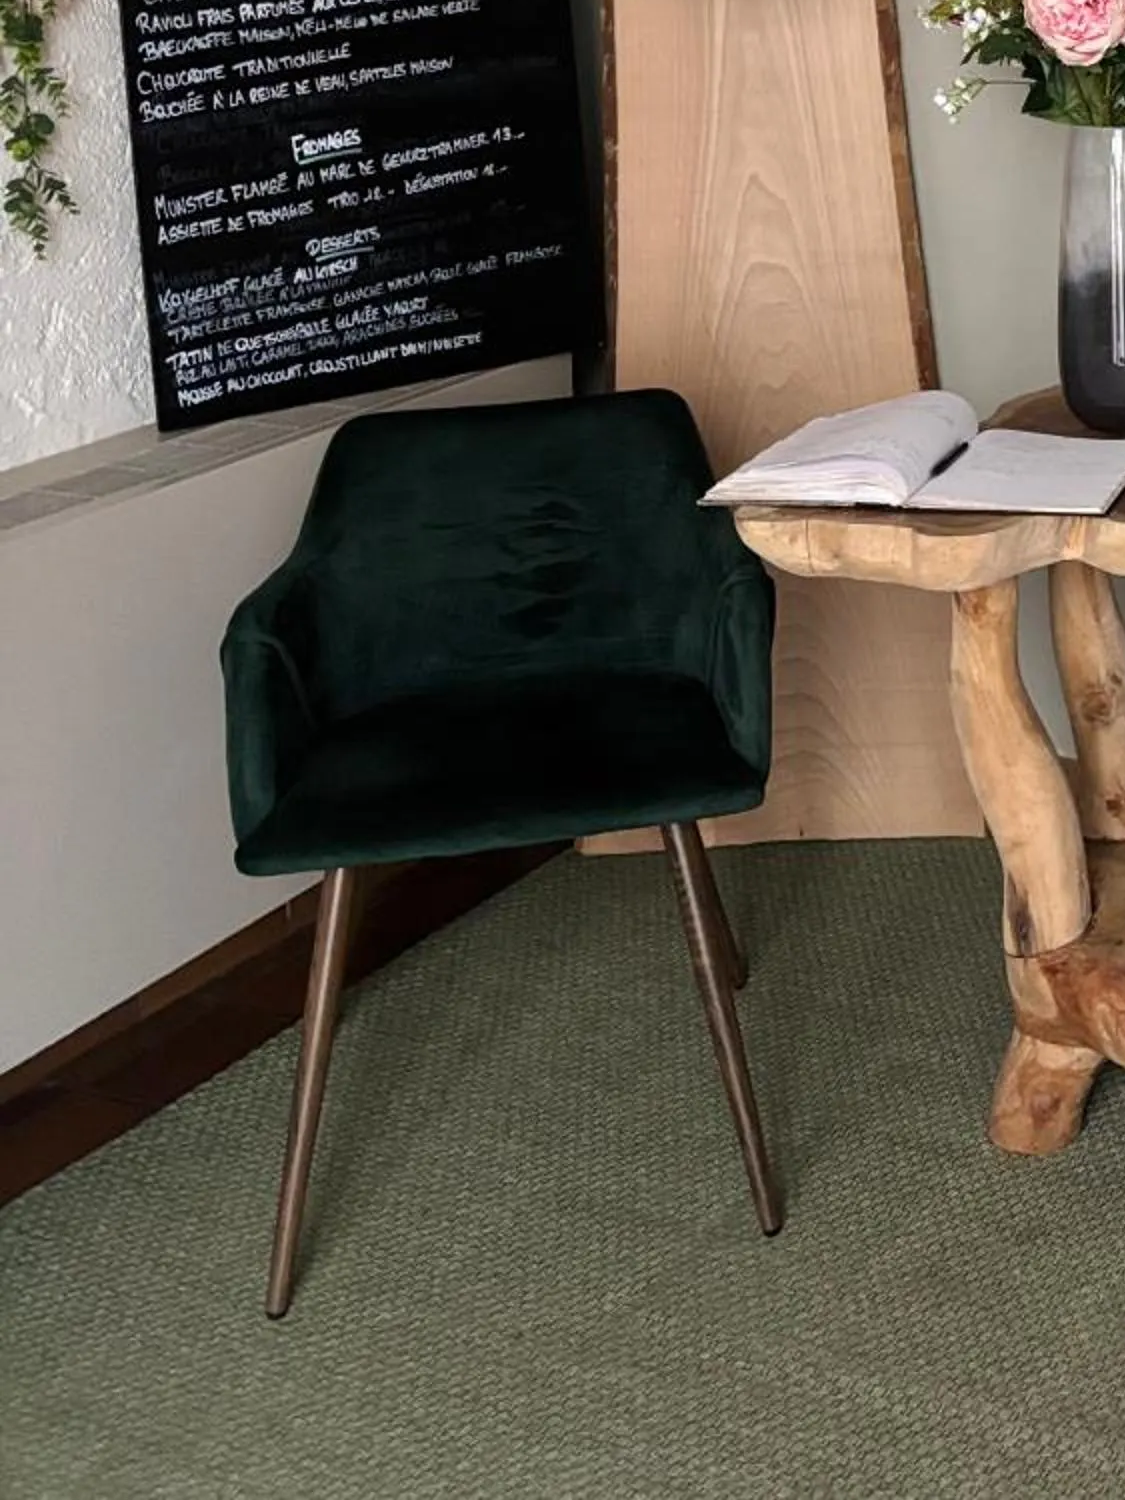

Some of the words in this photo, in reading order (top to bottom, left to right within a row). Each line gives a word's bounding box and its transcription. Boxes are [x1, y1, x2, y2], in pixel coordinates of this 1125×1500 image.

[136, 11, 193, 35] RAVIOLI
[197, 7, 235, 27] FRAIS
[370, 11, 389, 26] DE
[392, 5, 440, 23] SALADE
[136, 64, 225, 96] CHOUCROUTE
[139, 91, 207, 123] BOUCHÉE
[229, 89, 246, 108] LA
[249, 82, 291, 106] REINE
[294, 79, 312, 95] DE
[409, 56, 455, 76] MAISON
[291, 128, 362, 162] FROMAGES
[154, 188, 228, 220] MUNSTER
[230, 172, 291, 202] FLAMBÉ
[297, 171, 315, 191] AU
[319, 163, 357, 184] MARC
[357, 159, 376, 177] DE
[157, 217, 224, 246] ASSIETTE
[227, 216, 245, 232] DE
[246, 200, 315, 229] FROMAGES
[328, 191, 359, 210] TRIO
[305, 226, 381, 257] DESSERTS
[293, 267, 312, 285] AU
[315, 256, 359, 281] KIRSCH
[165, 345, 214, 370] TATIN
[217, 338, 233, 352] DE
[251, 348, 306, 365] CARAMEL
[177, 381, 224, 408] MOUSSE
[227, 377, 245, 393] AU
